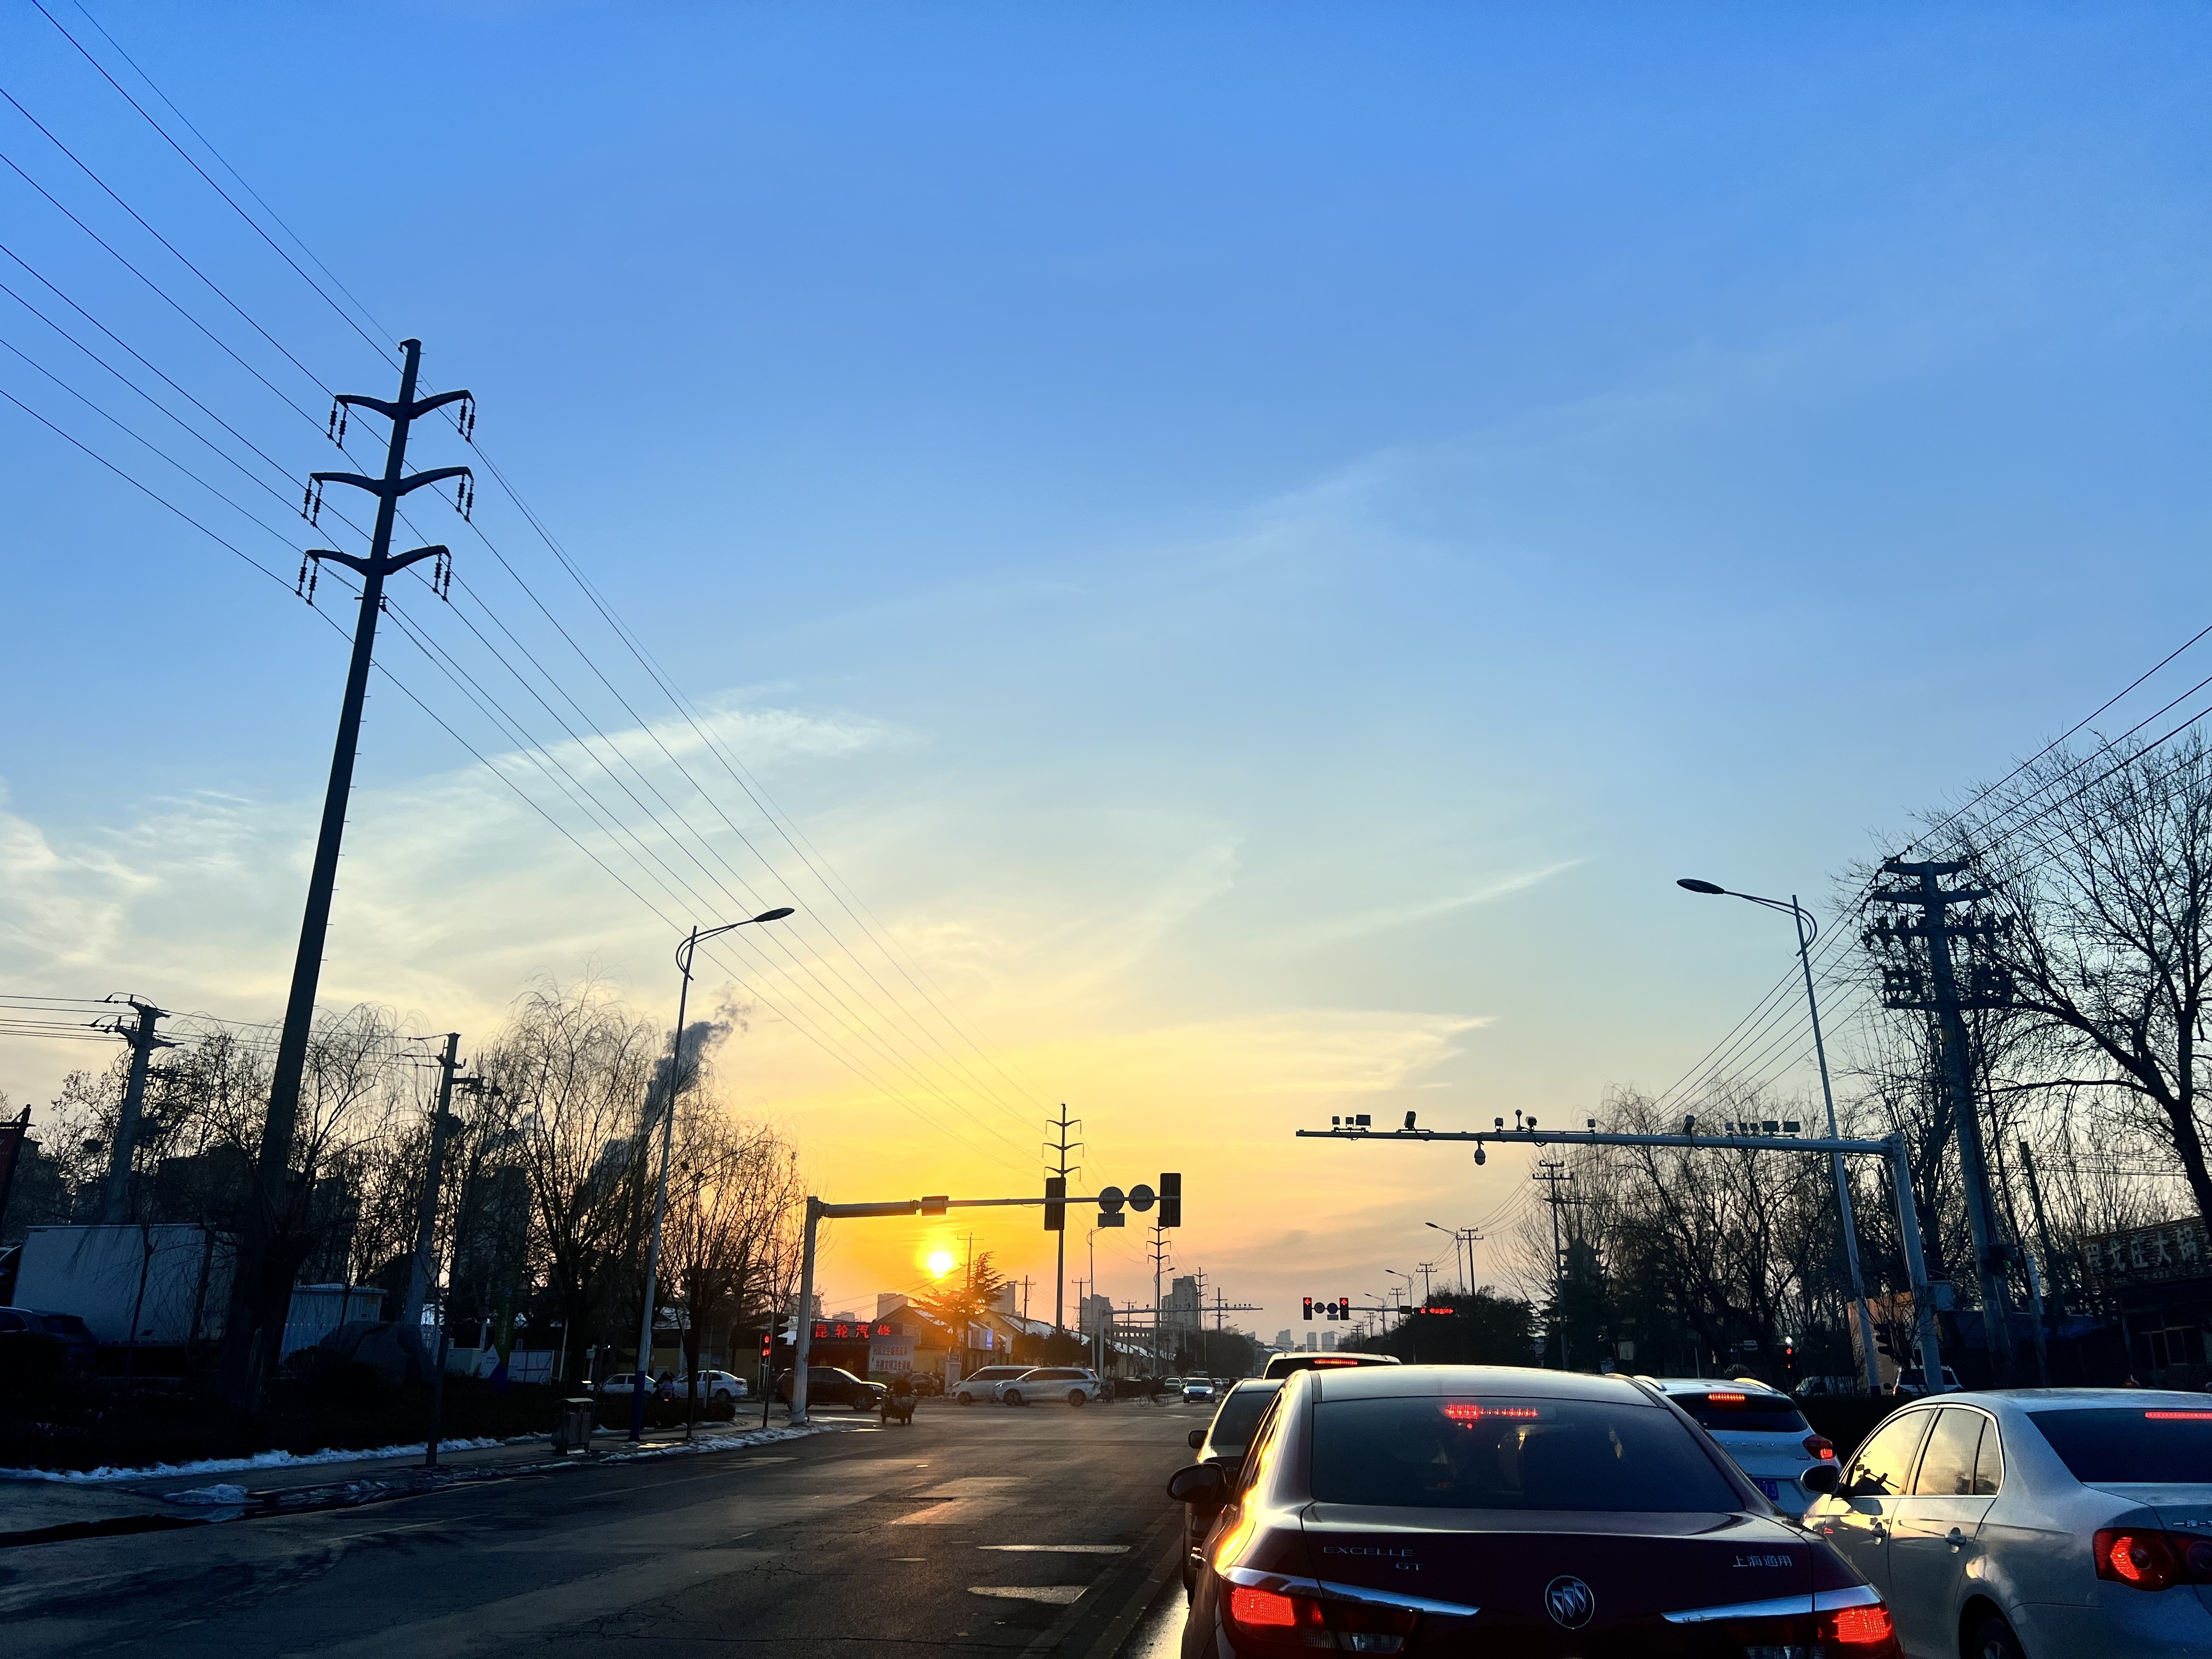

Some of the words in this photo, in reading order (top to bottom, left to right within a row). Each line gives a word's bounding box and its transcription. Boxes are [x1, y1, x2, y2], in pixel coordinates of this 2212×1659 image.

[815, 1323, 891, 1338] 昆轮汽修
[1758, 1484, 1777, 1497] 73
[1324, 1546, 1413, 1556] EXCELLE
[1396, 1562, 1424, 1571] GT
[1733, 1555, 1792, 1567] 上海通用
